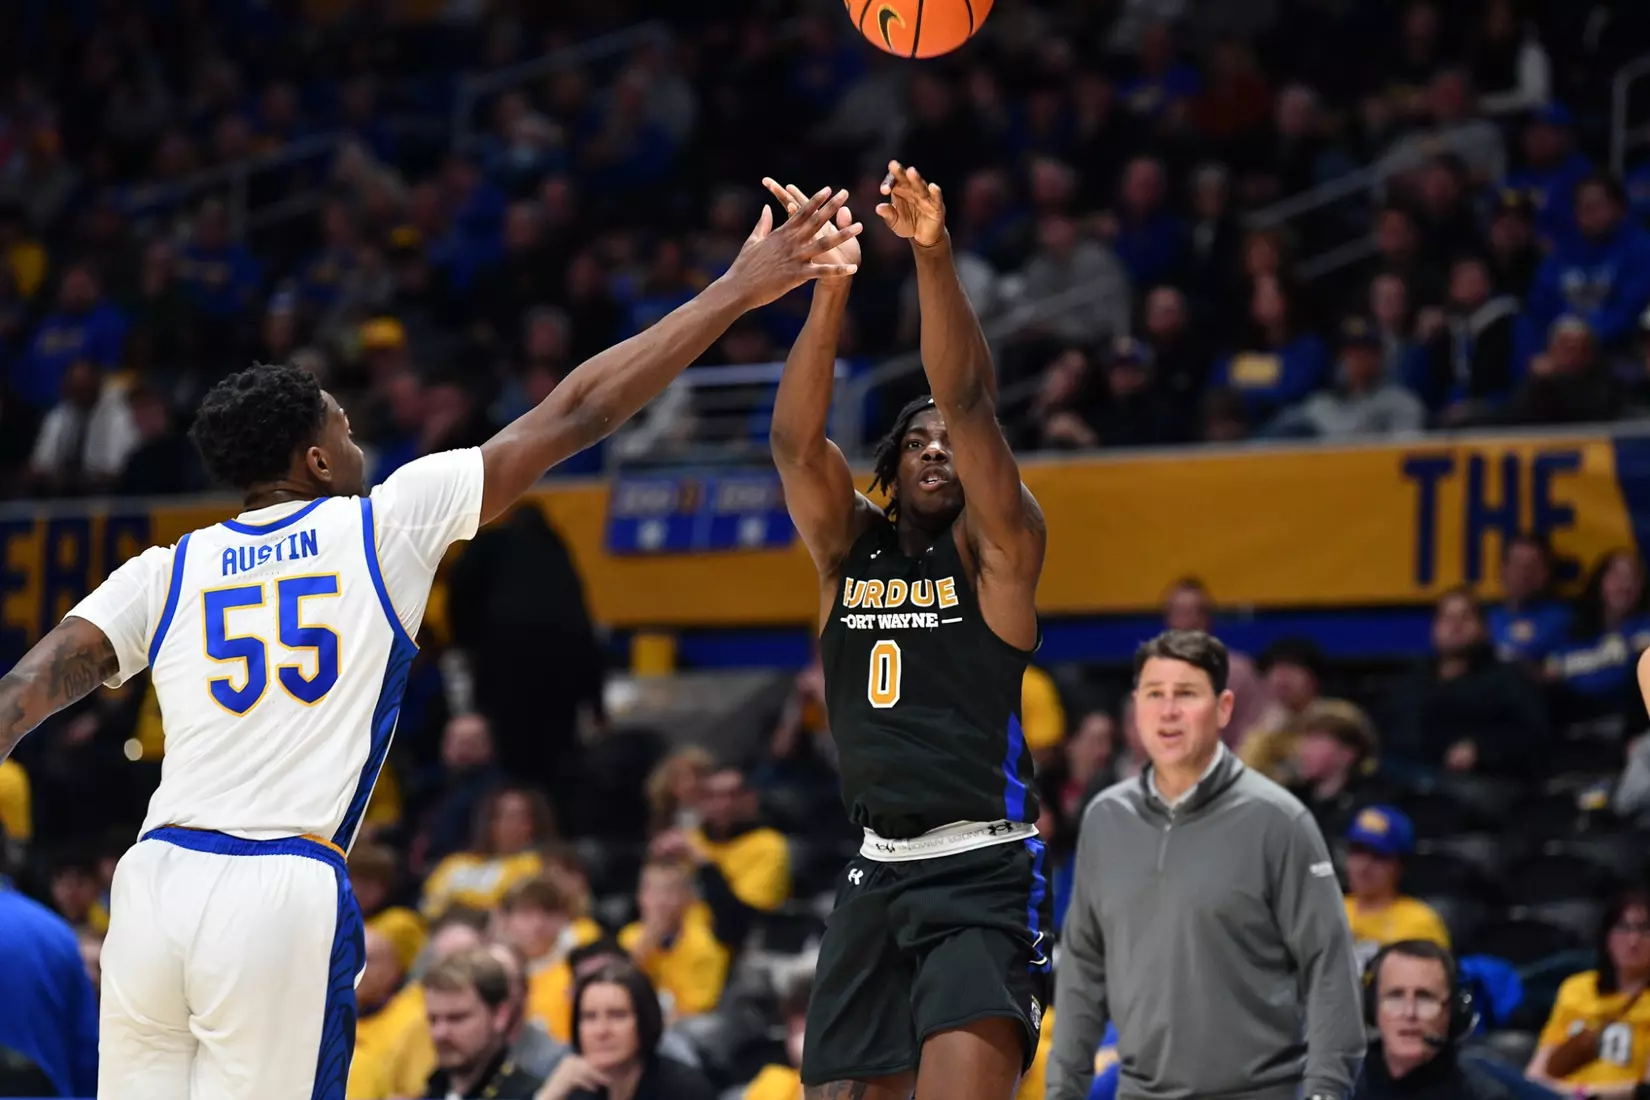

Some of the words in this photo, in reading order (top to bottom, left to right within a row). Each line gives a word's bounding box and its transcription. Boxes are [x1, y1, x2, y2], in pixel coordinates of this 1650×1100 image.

[222, 528, 318, 577] AUSTIN
[1402, 451, 1582, 587] THE
[200, 571, 342, 718] 55
[846, 613, 876, 630] ORT
[877, 612, 939, 630] WAYNE
[868, 639, 901, 709] 0
